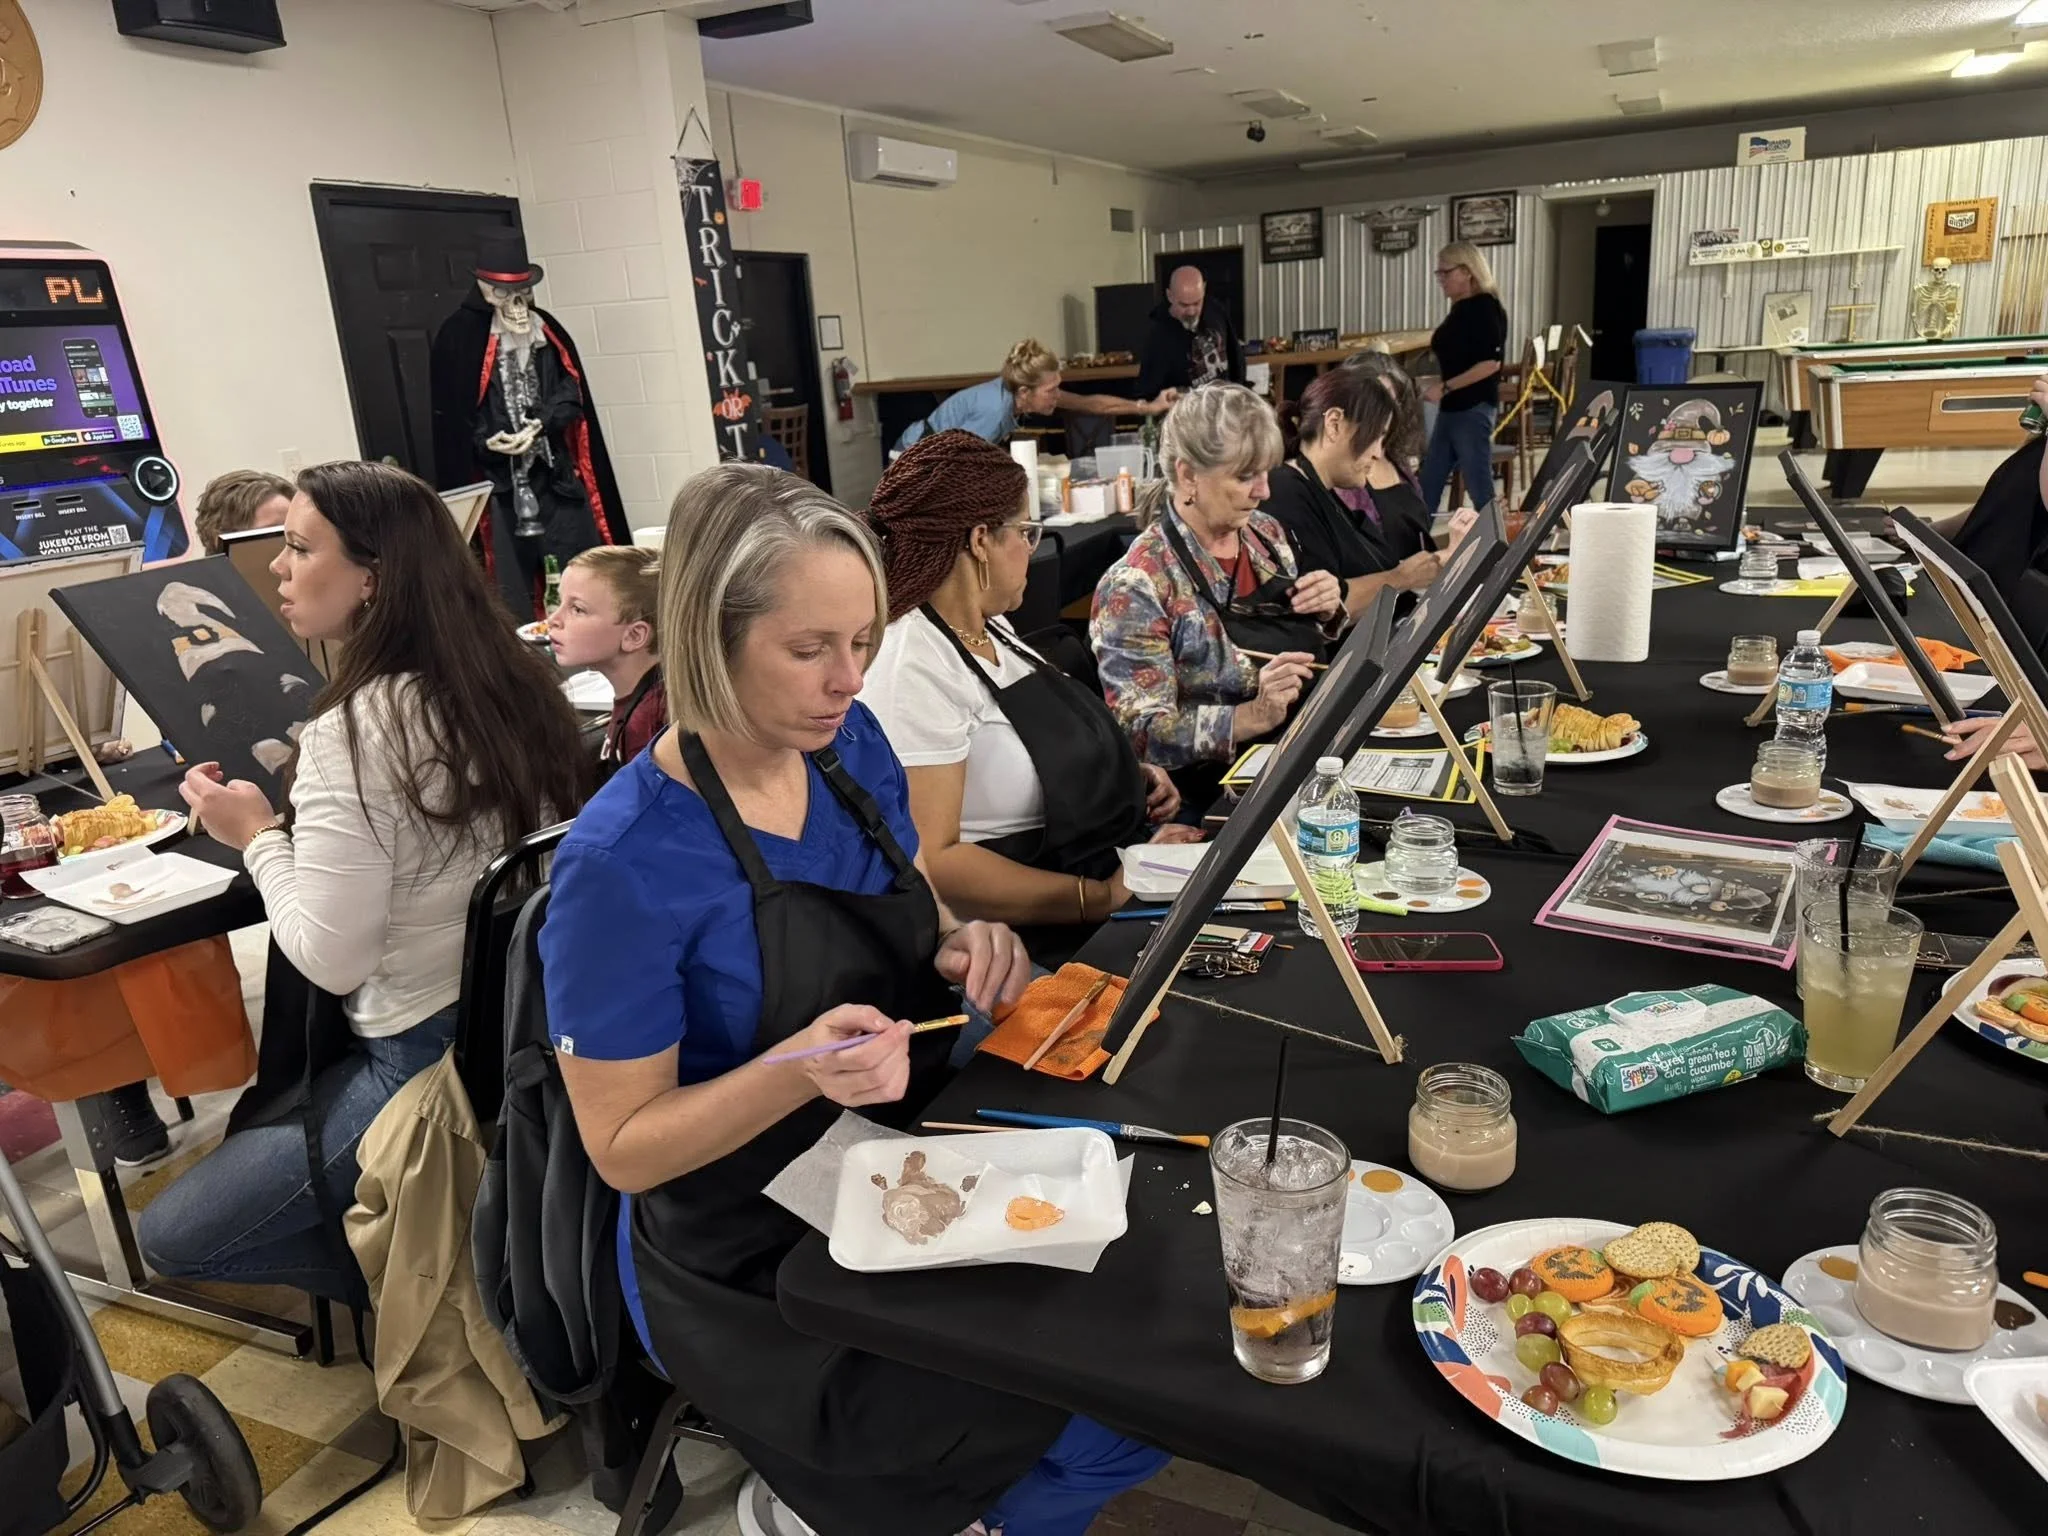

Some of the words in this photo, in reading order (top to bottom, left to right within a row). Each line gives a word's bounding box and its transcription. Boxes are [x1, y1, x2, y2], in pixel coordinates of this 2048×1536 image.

[44, 276, 104, 304] PL
[691, 185, 745, 388] TRICK
[0, 354, 36, 374] oad
[7, 397, 54, 411] together
[722, 398, 746, 420] OR
[725, 423, 748, 460] T
[64, 528, 82, 536] PLAY
[83, 525, 98, 533] THE
[39, 536, 81, 550] JUKEBOX
[82, 532, 109, 543] FROM
[1688, 1053, 1713, 1068] green
[1715, 1050, 1731, 1060] tea
[1731, 1047, 1738, 1056] &
[1743, 1045, 1753, 1058] DO
[1660, 1054, 1685, 1071] gree
[1690, 1059, 1735, 1076] cucumber
[1664, 1066, 1686, 1078] cucu
